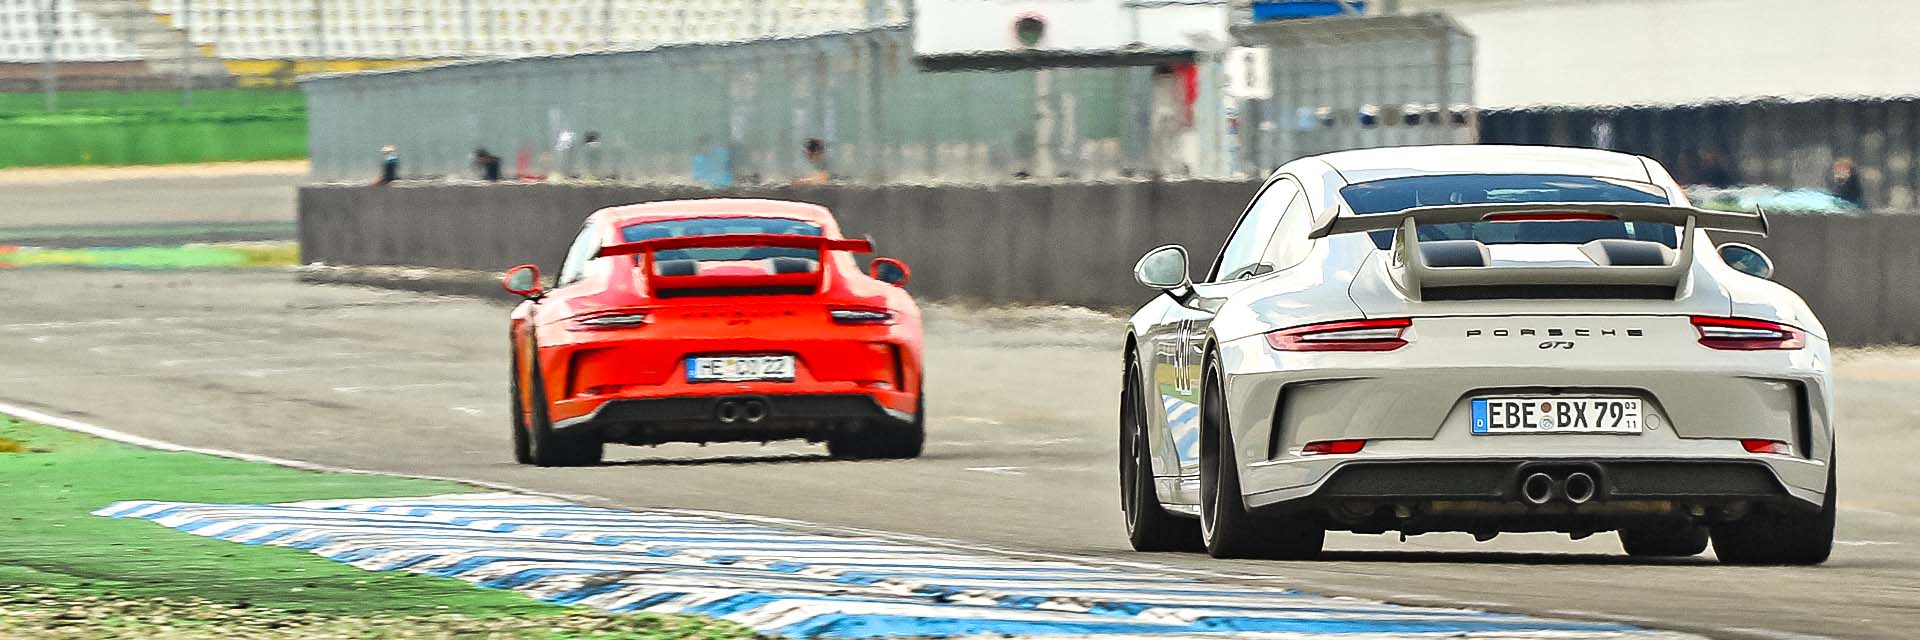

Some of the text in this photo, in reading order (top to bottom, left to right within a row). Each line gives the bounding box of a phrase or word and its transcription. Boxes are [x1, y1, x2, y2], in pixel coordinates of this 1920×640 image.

[1466, 329, 1644, 337] PORSCHE
[1538, 341, 1575, 350] GT3
[1625, 402, 1636, 410] 03
[1477, 402, 1623, 429] D EBE BX 79
[1627, 420, 1637, 429] 11
